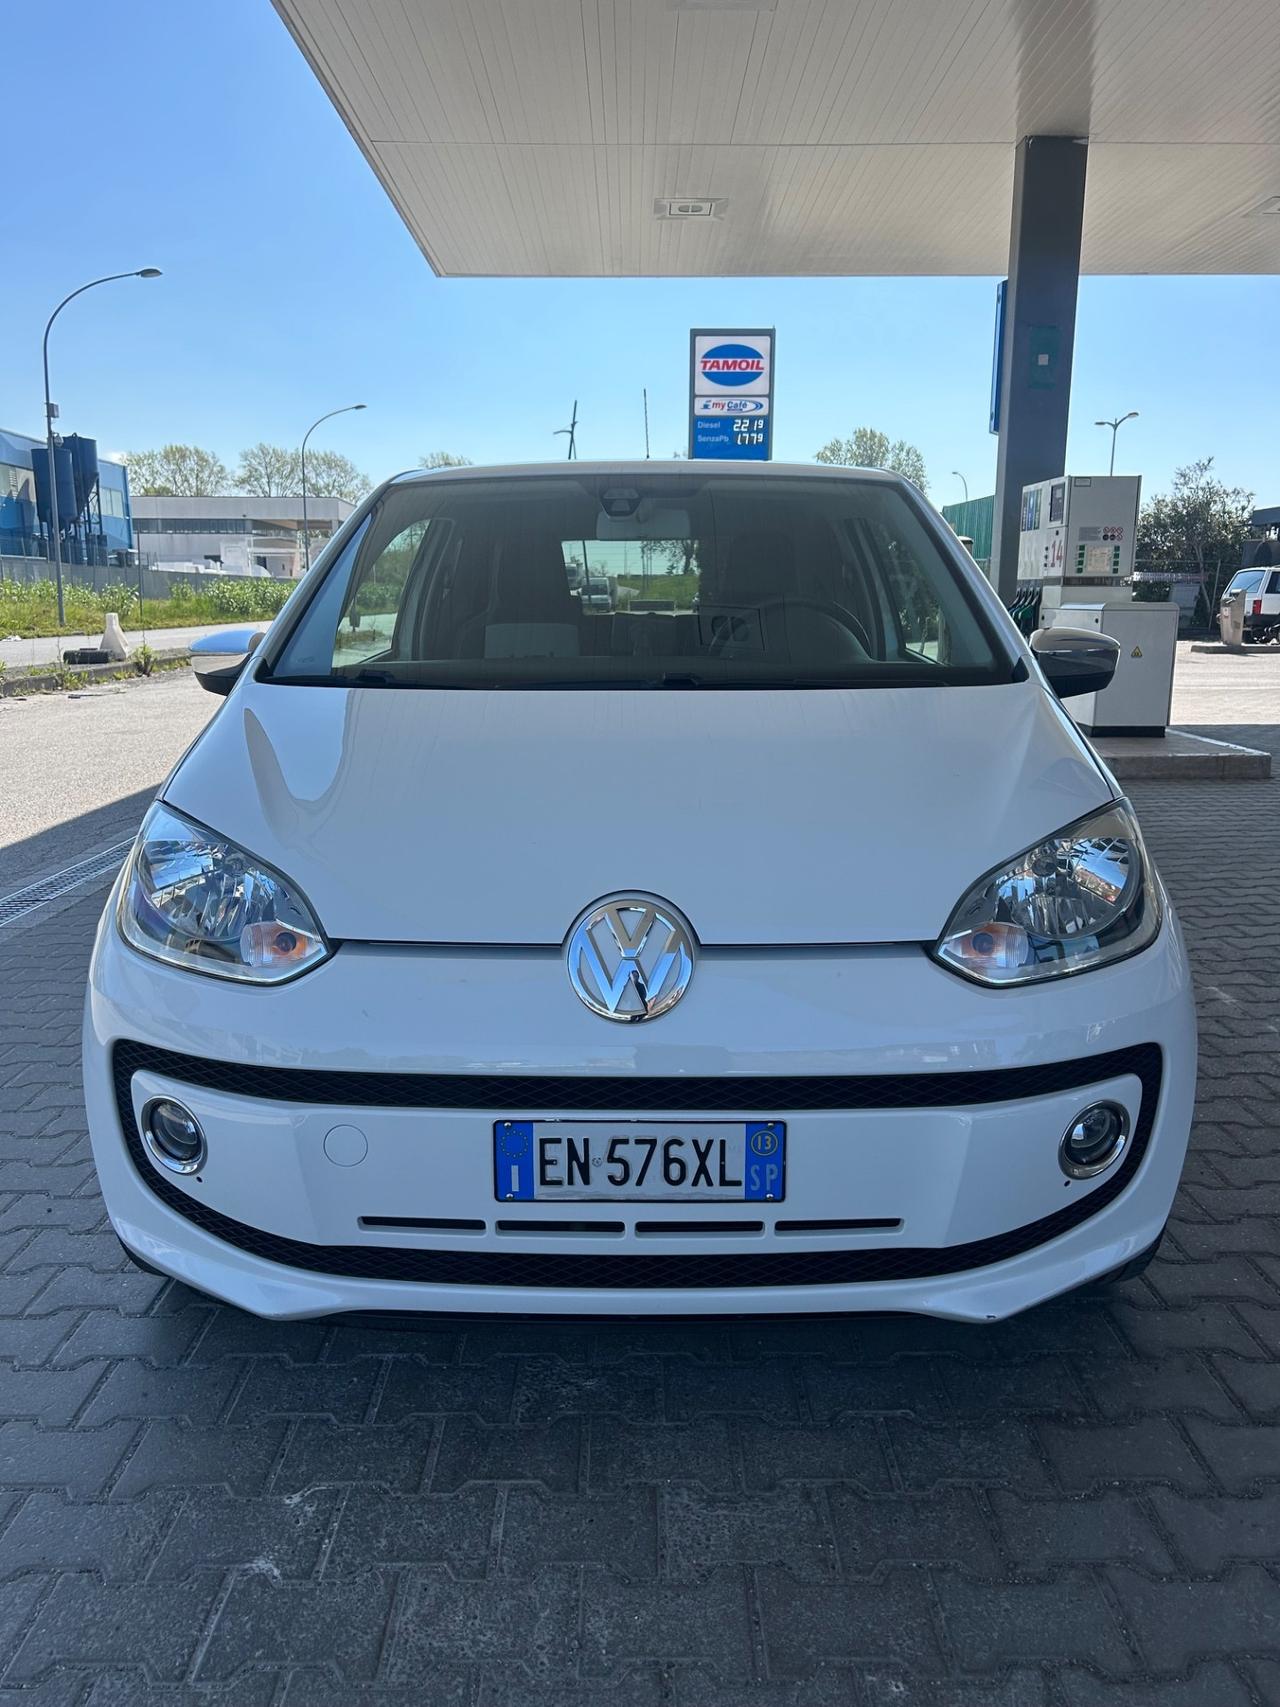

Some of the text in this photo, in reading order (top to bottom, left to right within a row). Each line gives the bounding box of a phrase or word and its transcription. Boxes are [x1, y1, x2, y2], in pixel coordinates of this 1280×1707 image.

[700, 359, 765, 371] TAMOIL
[712, 401, 726, 411] my
[697, 419, 764, 431] Diesel 2219
[1051, 540, 1063, 568] 14
[757, 1135, 772, 1150] 13
[539, 1136, 742, 1187] EN 576XL
[750, 1163, 779, 1191] SP
